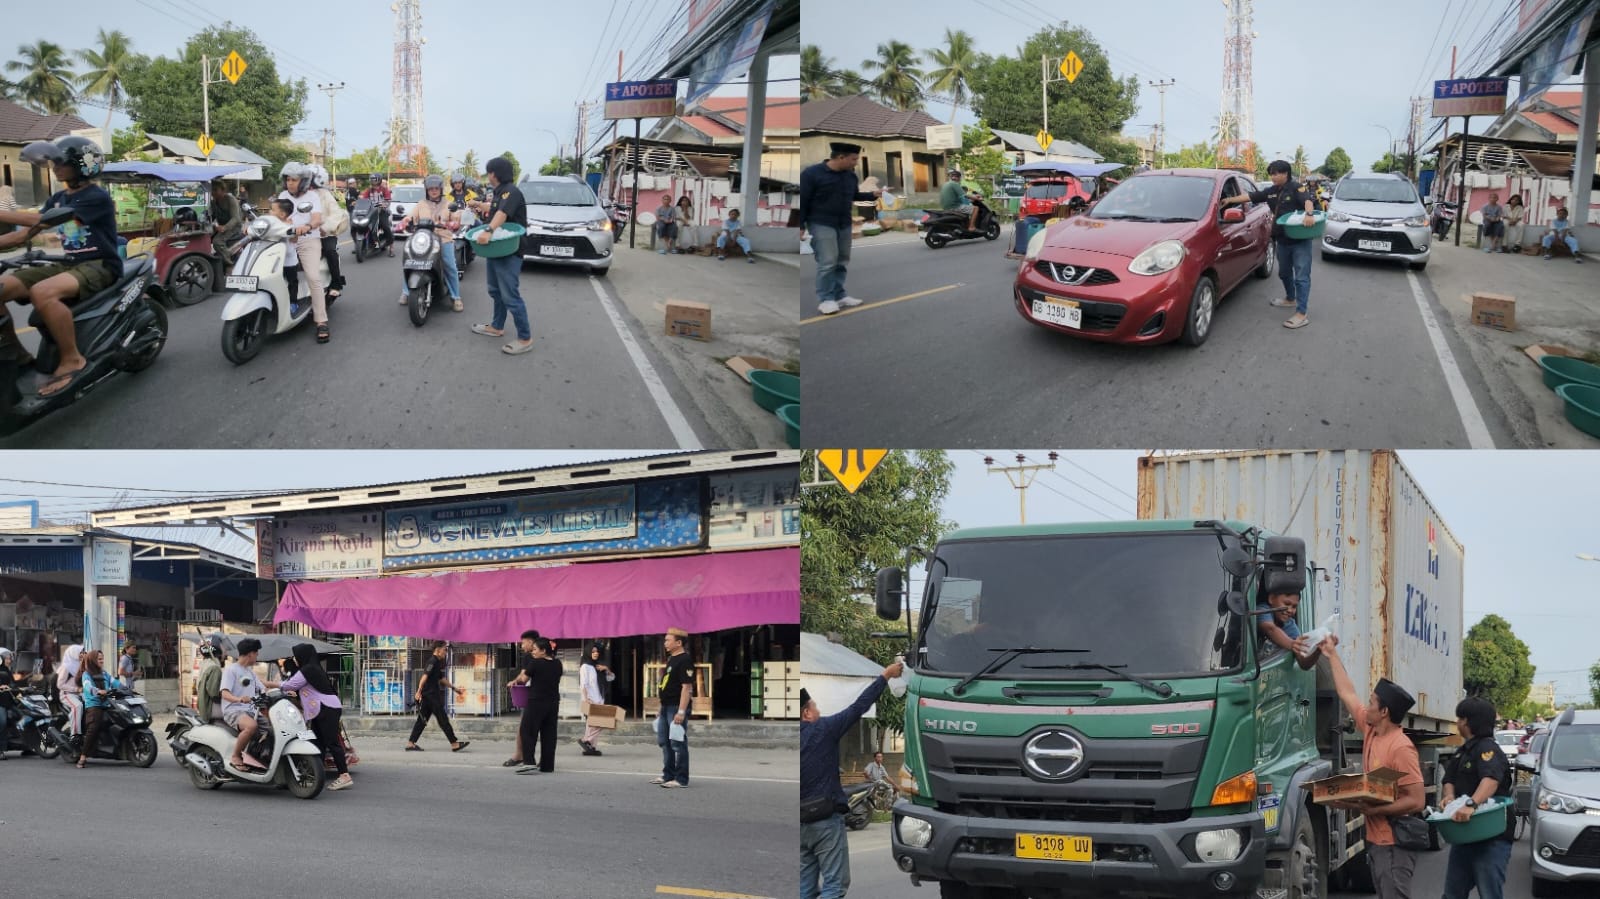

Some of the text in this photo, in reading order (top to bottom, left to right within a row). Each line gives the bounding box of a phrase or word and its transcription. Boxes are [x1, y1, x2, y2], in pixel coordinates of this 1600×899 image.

[622, 83, 673, 97] APOTEK
[1450, 80, 1504, 95] APOTEK
[522, 514, 547, 536] ES
[277, 532, 373, 556] Kirana Kayla
[925, 718, 977, 732] HINO
[1151, 722, 1201, 735] 500
[1018, 836, 1089, 853] L 8198 UV
